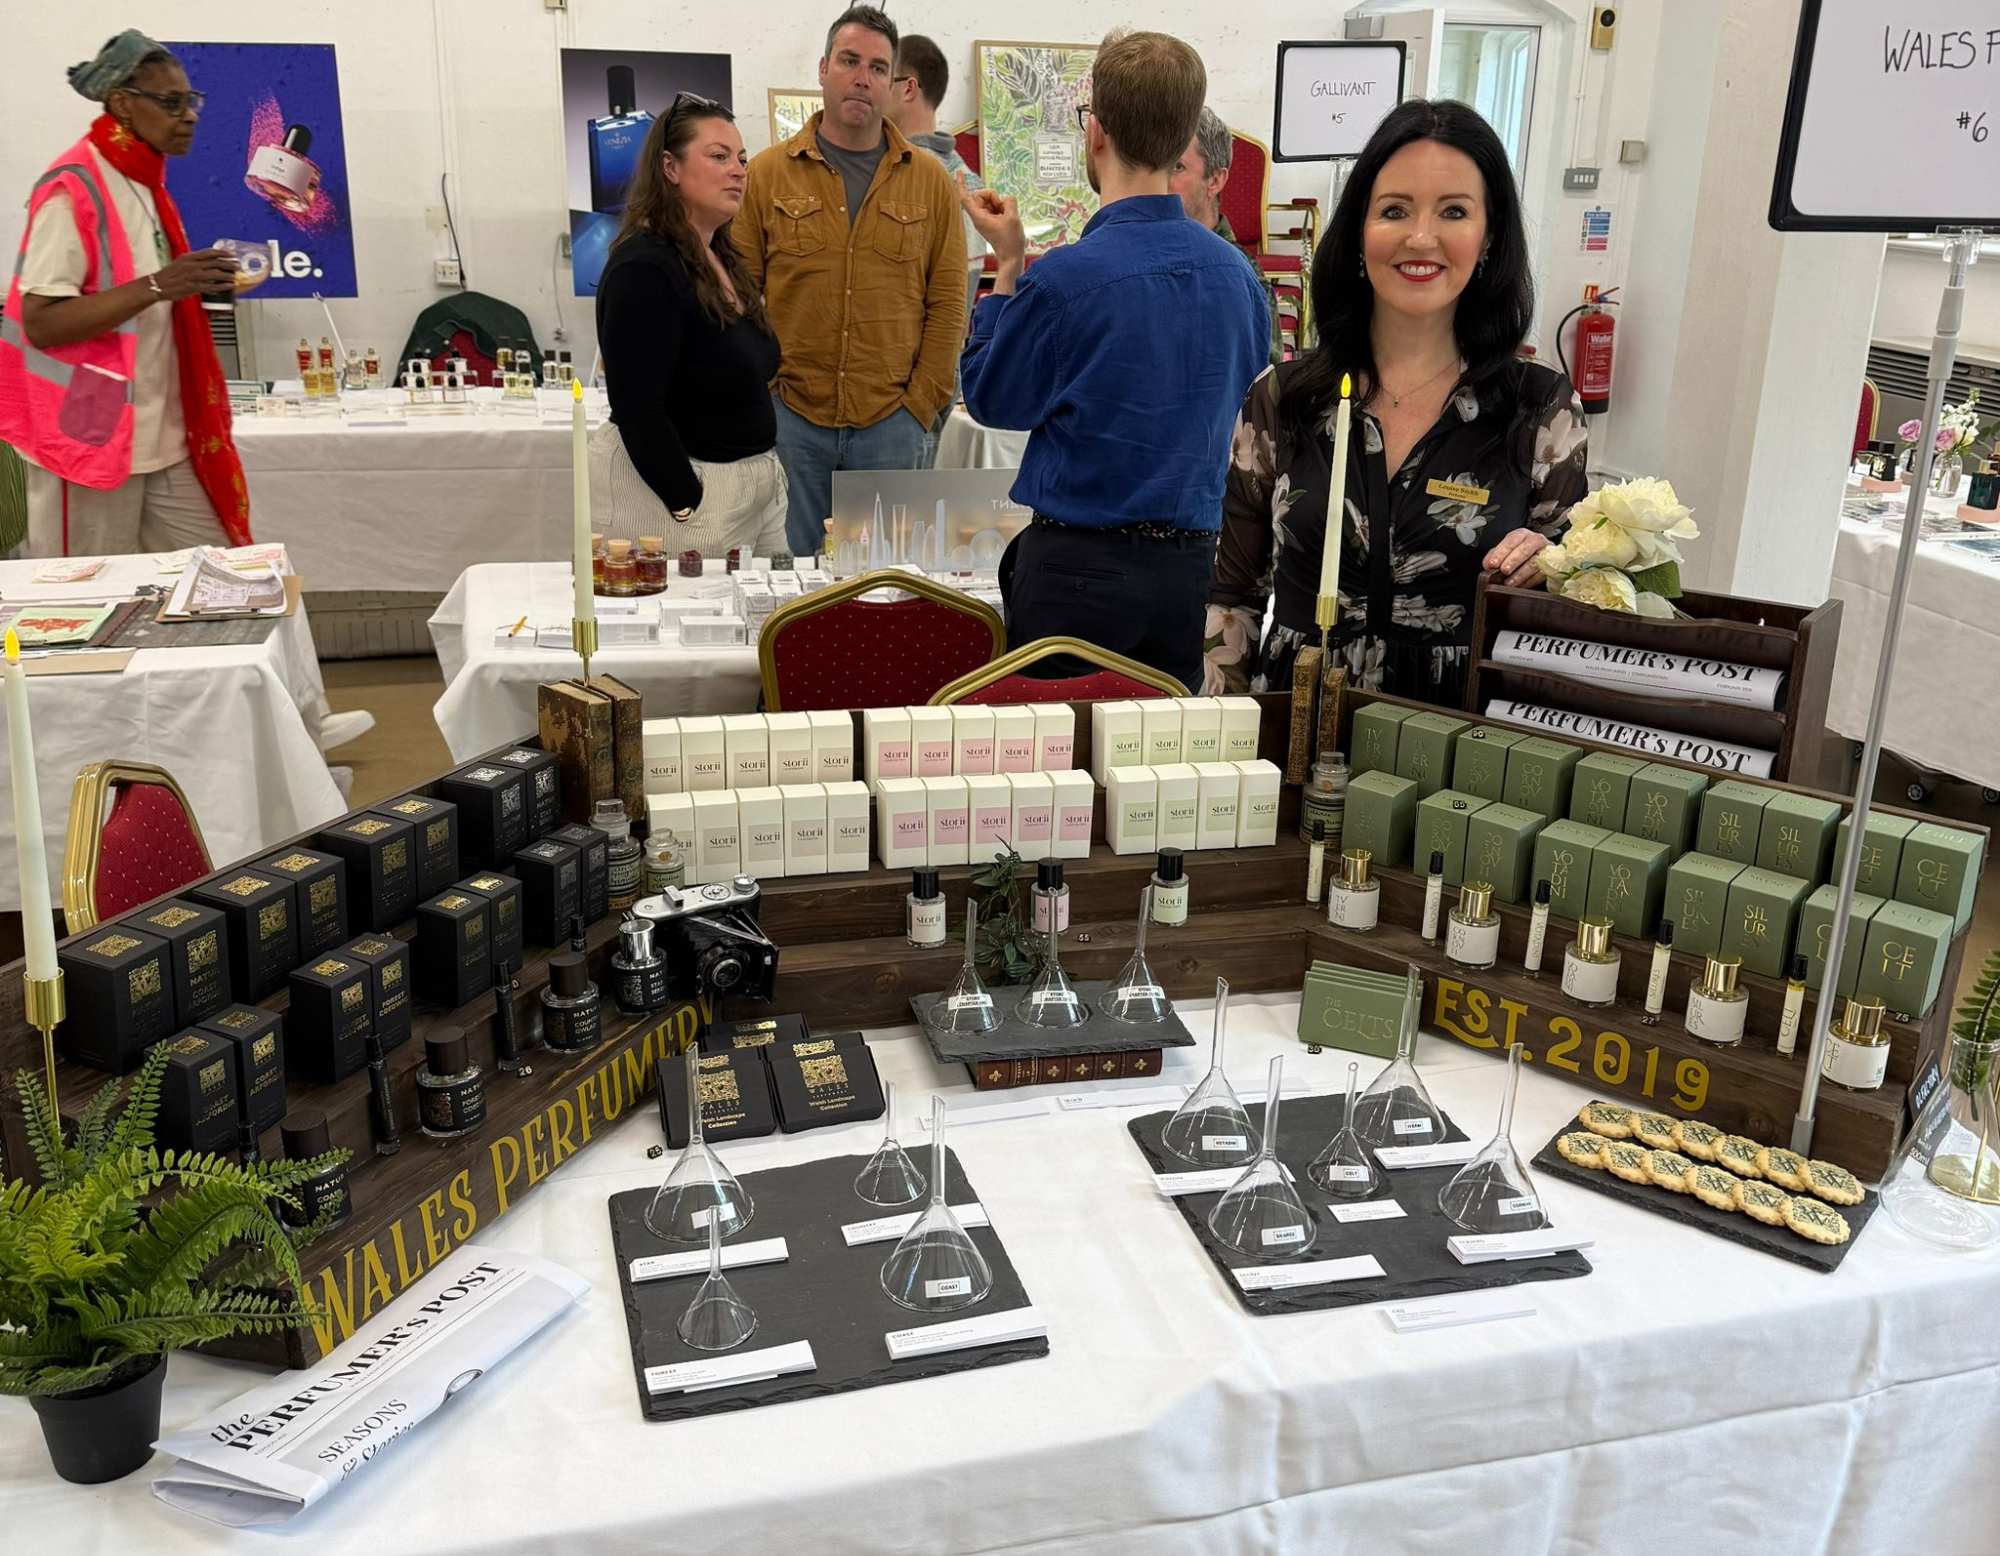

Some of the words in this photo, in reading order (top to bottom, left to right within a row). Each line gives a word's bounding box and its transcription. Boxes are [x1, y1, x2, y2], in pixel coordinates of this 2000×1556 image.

[1885, 25, 1976, 72] WALES
[1310, 80, 1376, 97] GALLIVANT
[1956, 111, 1988, 143] #6
[1680, 659, 1760, 682] POST
[1673, 739, 1751, 772] POST
[1719, 811, 1742, 828] SIL
[1779, 826, 1801, 843] SIL
[1158, 895, 1183, 906] storii
[916, 913, 942, 925] storii
[1744, 904, 1768, 922] SIL
[1743, 920, 1769, 937] UR
[1882, 941, 1917, 964] CE
[382, 991, 405, 1008] FOREST
[1322, 1007, 1394, 1040] CELTS
[518, 1065, 532, 1076] 26
[708, 1120, 737, 1129] Collection
[302, 1168, 477, 1358] WALES
[427, 1261, 504, 1315] POST
[891, 1329, 916, 1340] COAST
[210, 1412, 256, 1443] the
[317, 1399, 408, 1462] SEASONS
